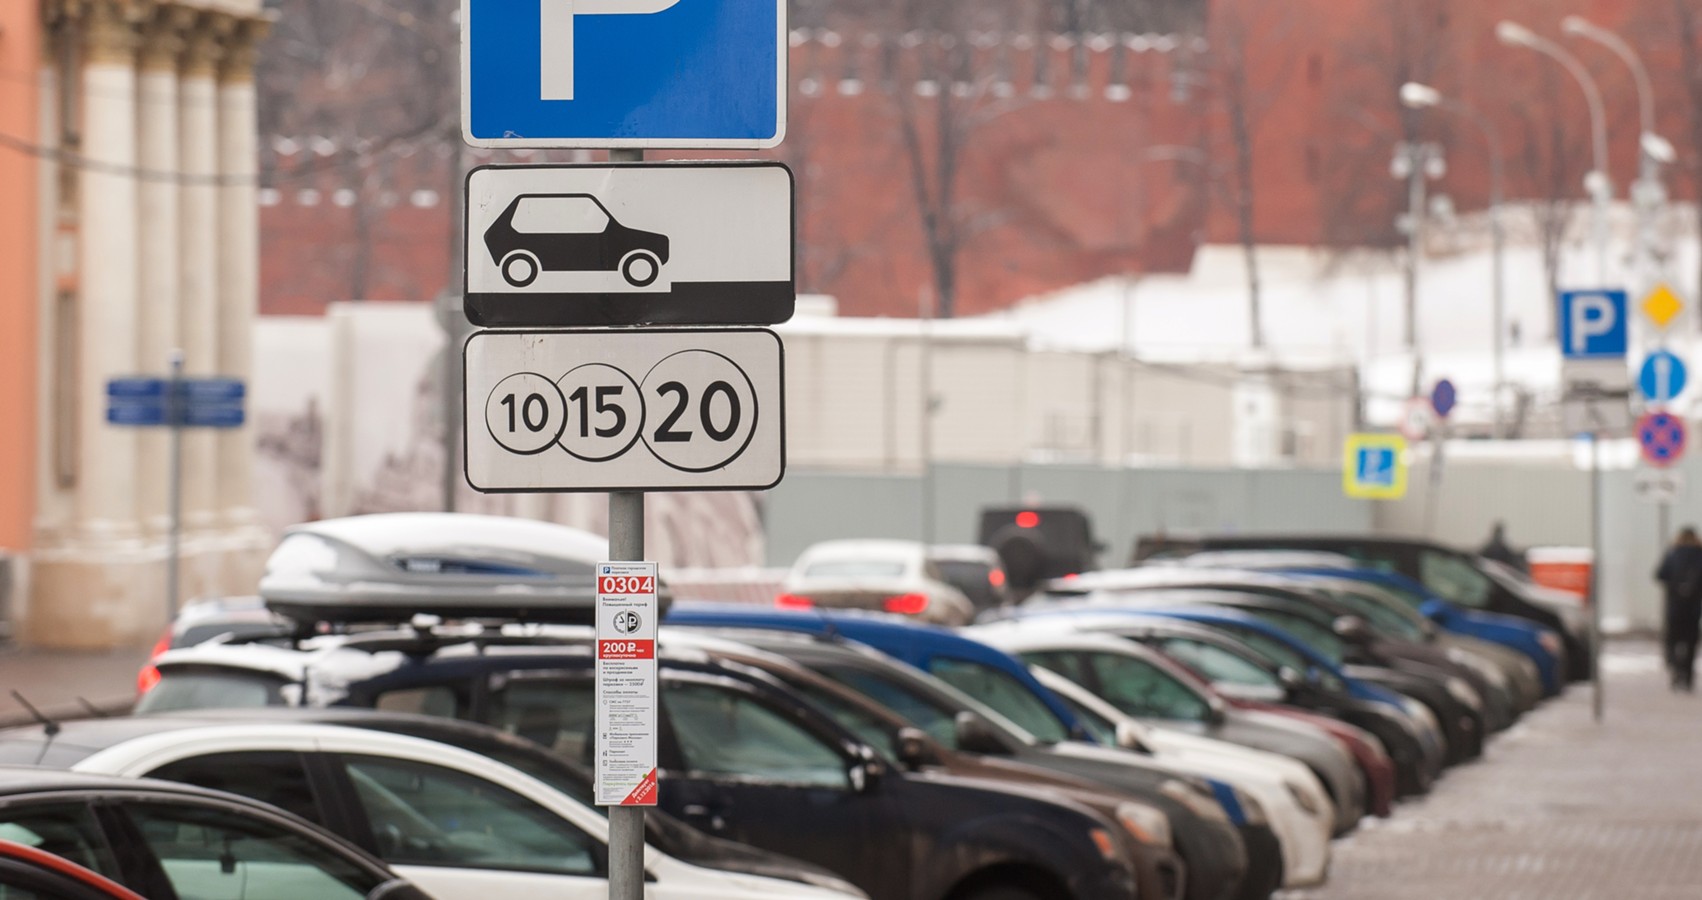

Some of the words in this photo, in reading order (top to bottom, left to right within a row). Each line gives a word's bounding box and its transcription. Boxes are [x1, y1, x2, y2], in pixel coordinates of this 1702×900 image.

[1569, 294, 1617, 353] P
[500, 393, 549, 433] 10
[568, 385, 626, 437] 15
[653, 380, 742, 442] 20
[603, 577, 653, 593] 0304
[603, 642, 626, 653] 200
